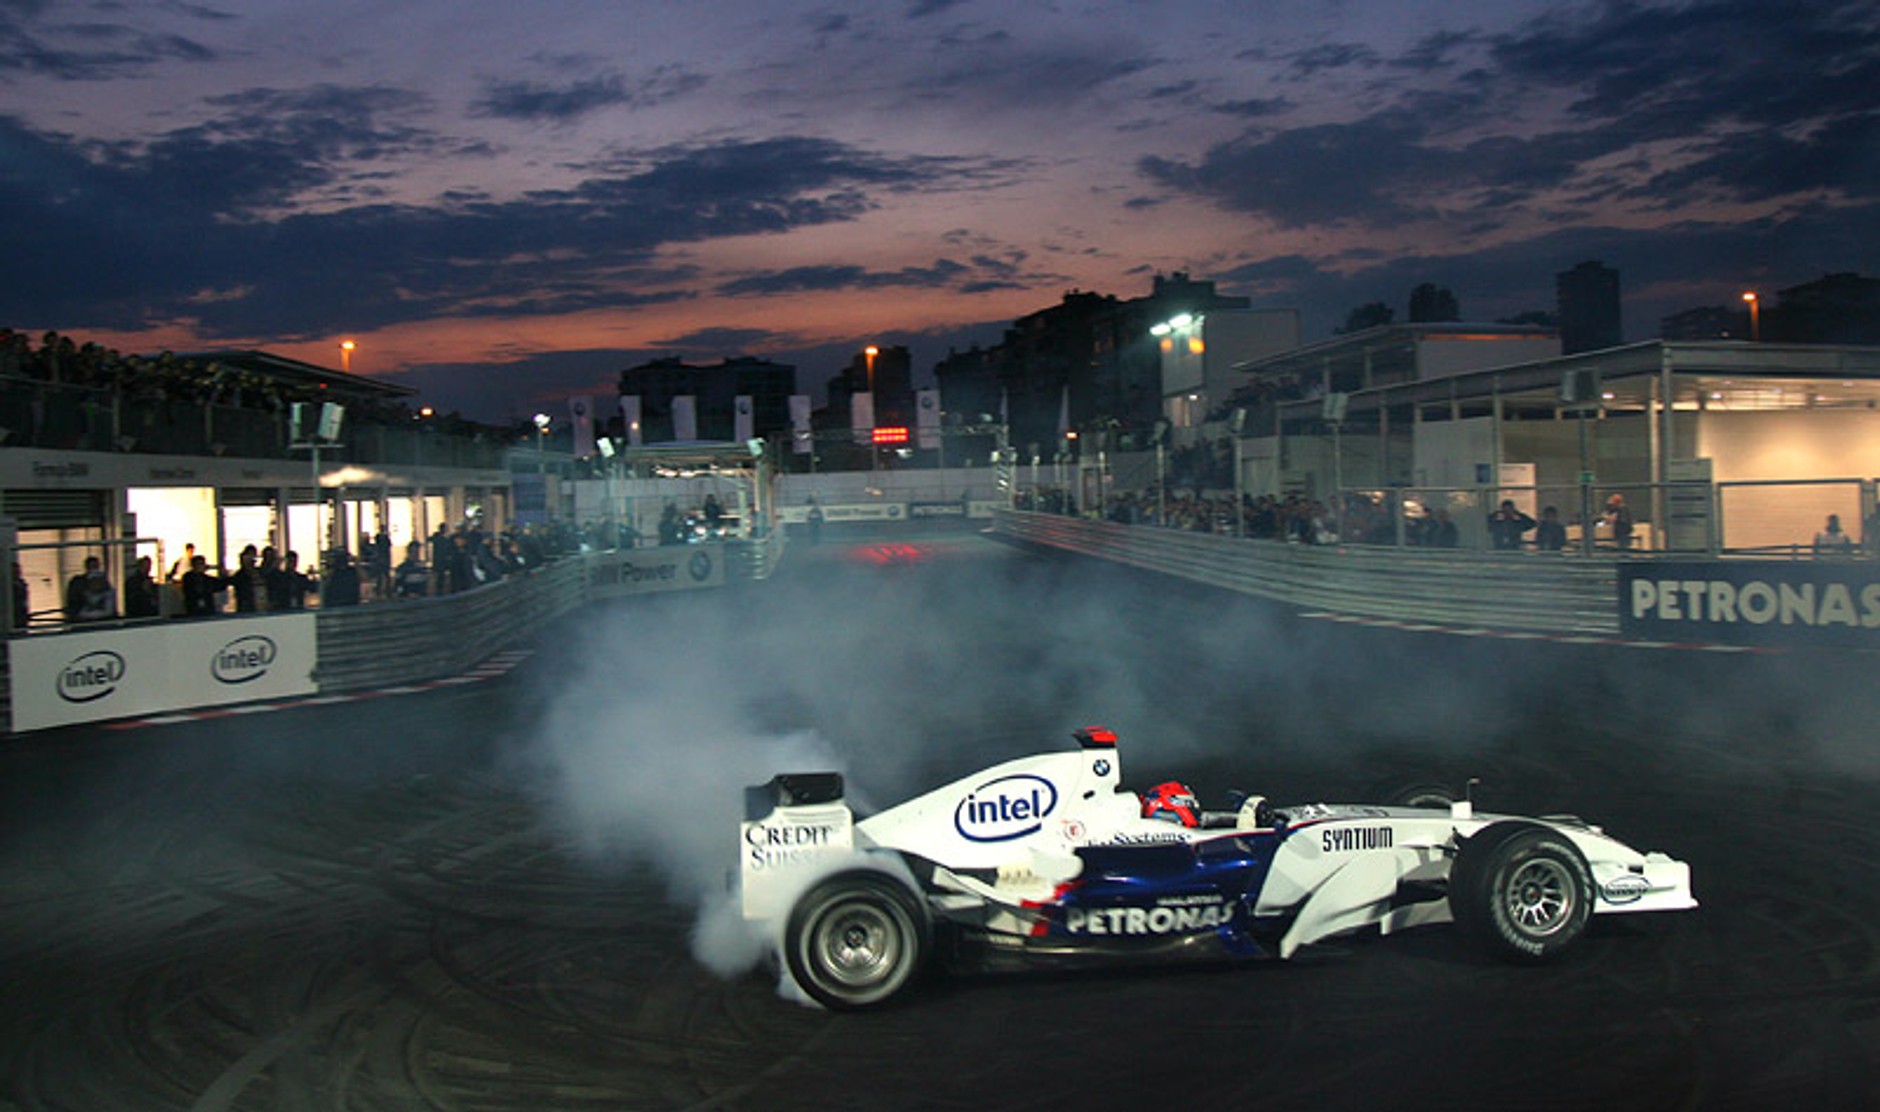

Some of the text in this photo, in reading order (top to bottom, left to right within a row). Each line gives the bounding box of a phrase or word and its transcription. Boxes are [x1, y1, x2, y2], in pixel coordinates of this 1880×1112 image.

[1631, 578, 1880, 628] PETRONAS
[212, 646, 267, 670] intel
[66, 661, 115, 688] intel
[968, 789, 1040, 824] intel
[745, 824, 833, 847] CREDIT
[1322, 826, 1393, 852] SYNTIUM
[1066, 900, 1238, 935] PETRONAS
